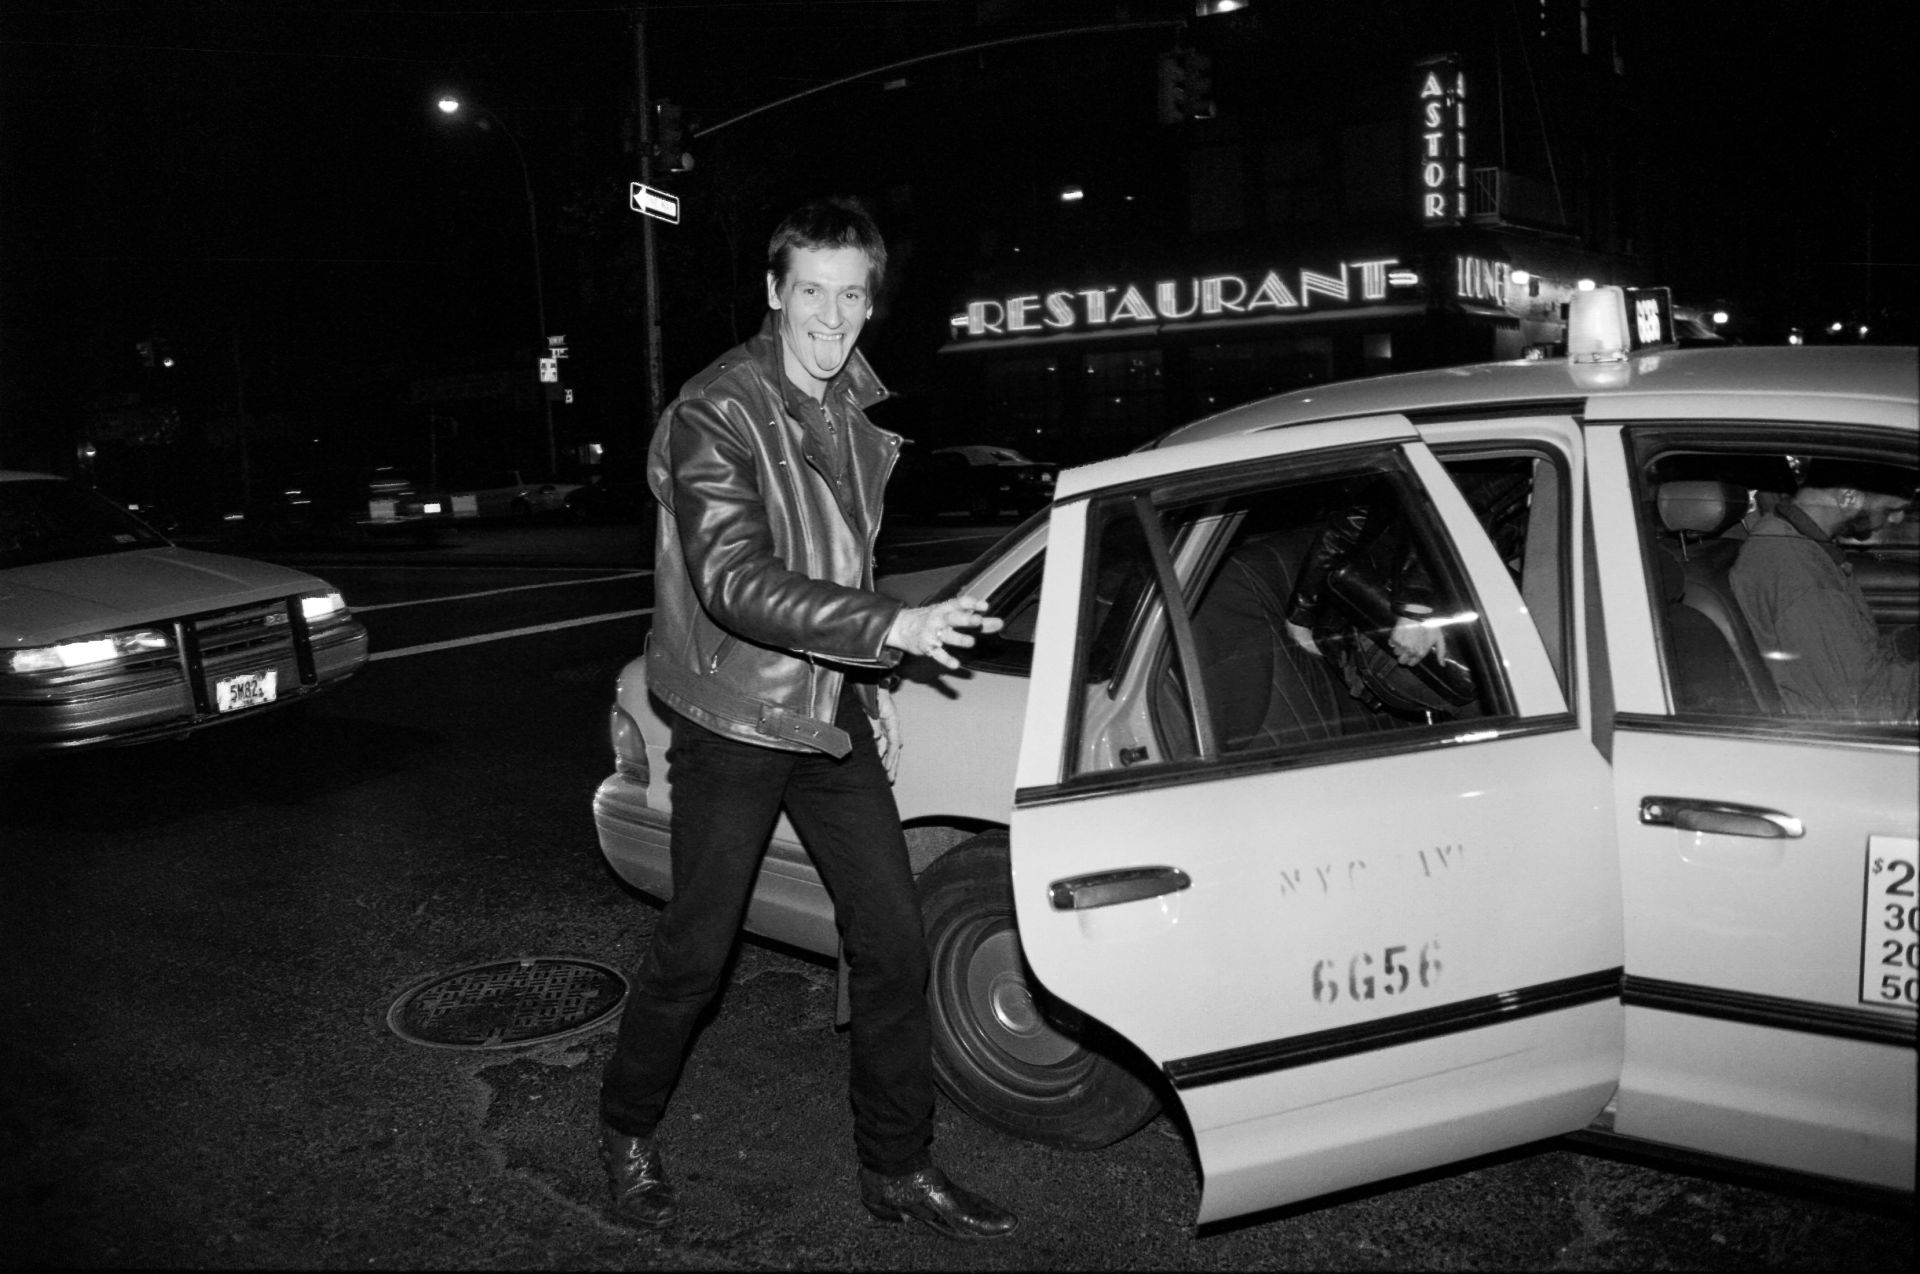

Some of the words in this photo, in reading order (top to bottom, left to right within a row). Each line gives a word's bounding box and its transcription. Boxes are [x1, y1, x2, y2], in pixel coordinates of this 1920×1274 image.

[1420, 71, 1445, 218] ASTOR
[967, 258, 1399, 335] RESTAURANT
[1312, 938, 1442, 1004] 6G56
